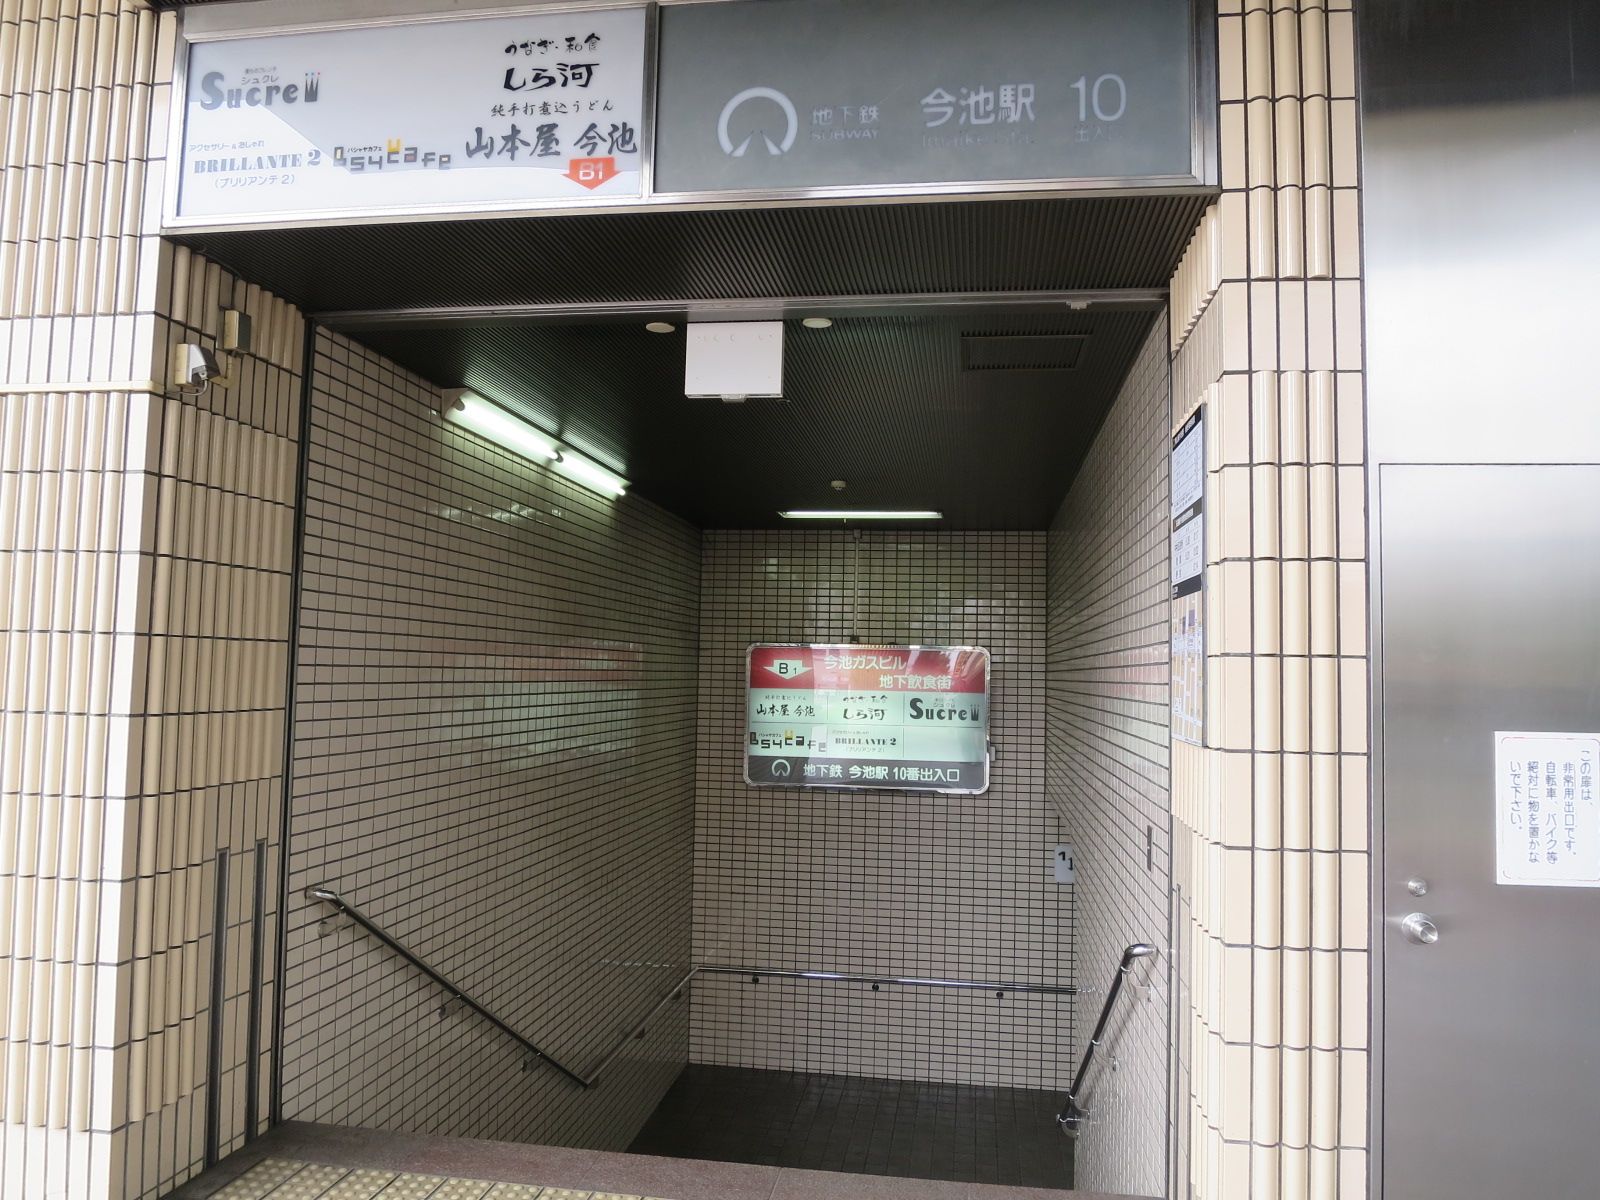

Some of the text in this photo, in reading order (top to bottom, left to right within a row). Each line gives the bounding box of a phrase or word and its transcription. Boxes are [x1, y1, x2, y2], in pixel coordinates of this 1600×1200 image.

[241, 76, 279, 85] シュクレ
[504, 63, 600, 91] しら河
[200, 71, 298, 110] Sucre
[1070, 73, 1127, 122] 10
[491, 100, 613, 117] 純手打煮込うどん
[812, 105, 880, 127] 地下鉄
[919, 83, 1036, 128] 今池駅
[466, 122, 638, 161] 山本屋 今池
[812, 128, 880, 141] SUBWAY
[194, 149, 321, 173] BRILLANTE 2
[579, 162, 603, 180] B1
[824, 655, 907, 670] 今池ガスビル
[879, 673, 952, 690] 地下飲食街
[756, 704, 816, 717] 山本屋 今池
[843, 707, 888, 721] しら河
[909, 697, 967, 721] Sucre
[890, 737, 897, 746] 2
[803, 764, 960, 782] 地下鉄 今池駅 10番出入口
[1580, 750, 1593, 806] この扉は、
[1510, 761, 1523, 830] いで下さい。
[1527, 761, 1541, 864] 絶対に物を置かな
[1545, 762, 1558, 864] 自転車、バイク等
[1563, 762, 1577, 855] 非常用出口です。
